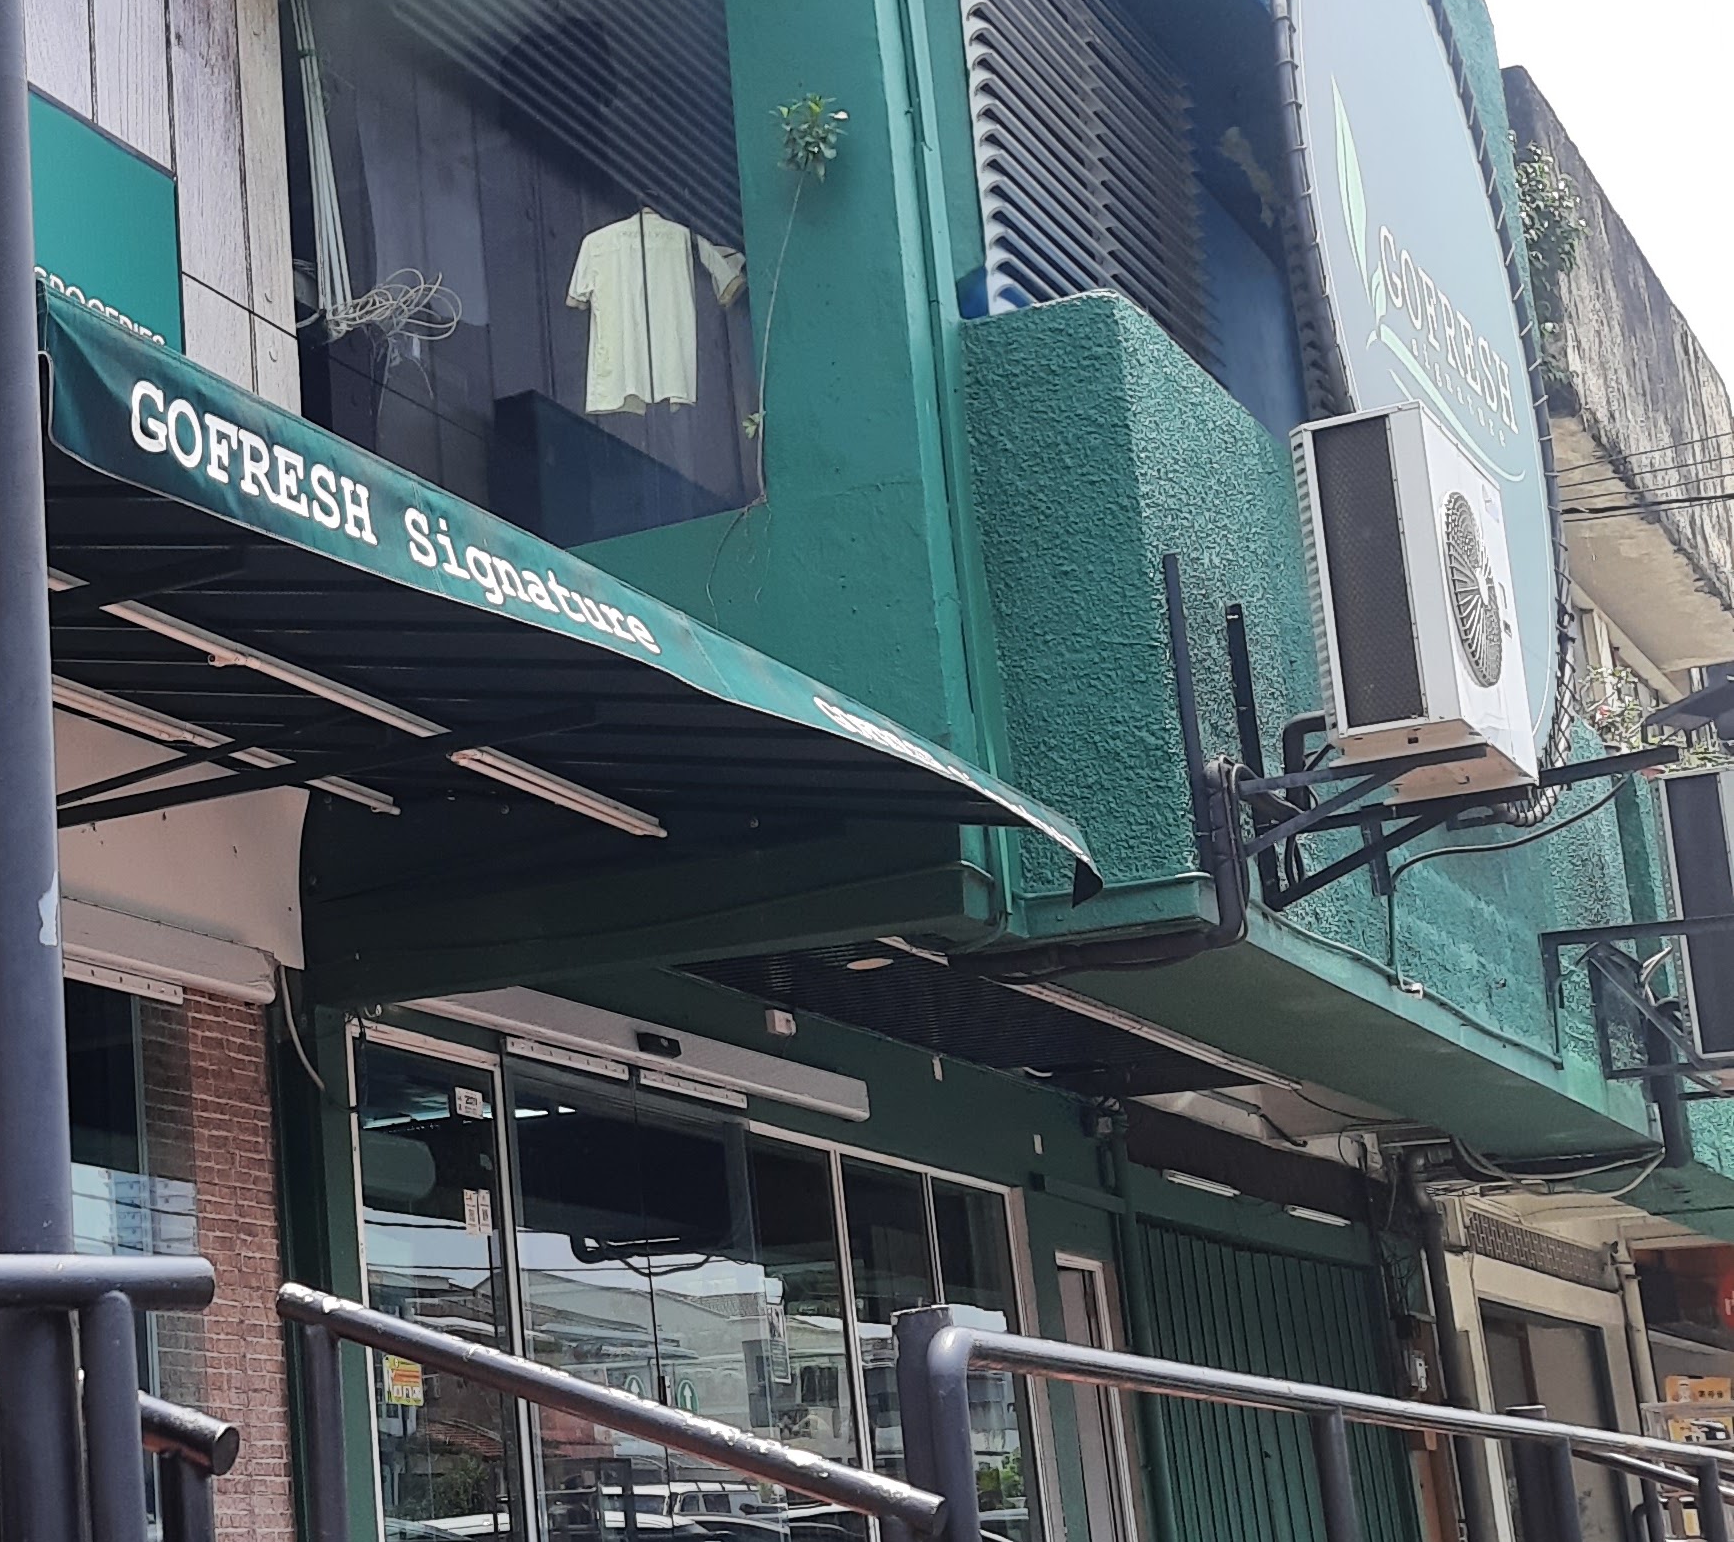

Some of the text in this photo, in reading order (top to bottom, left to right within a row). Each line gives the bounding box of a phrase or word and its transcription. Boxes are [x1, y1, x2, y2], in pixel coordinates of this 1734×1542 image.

[1379, 225, 1519, 435] GOFRESH
[130, 379, 662, 655] GOFRESH Signature
